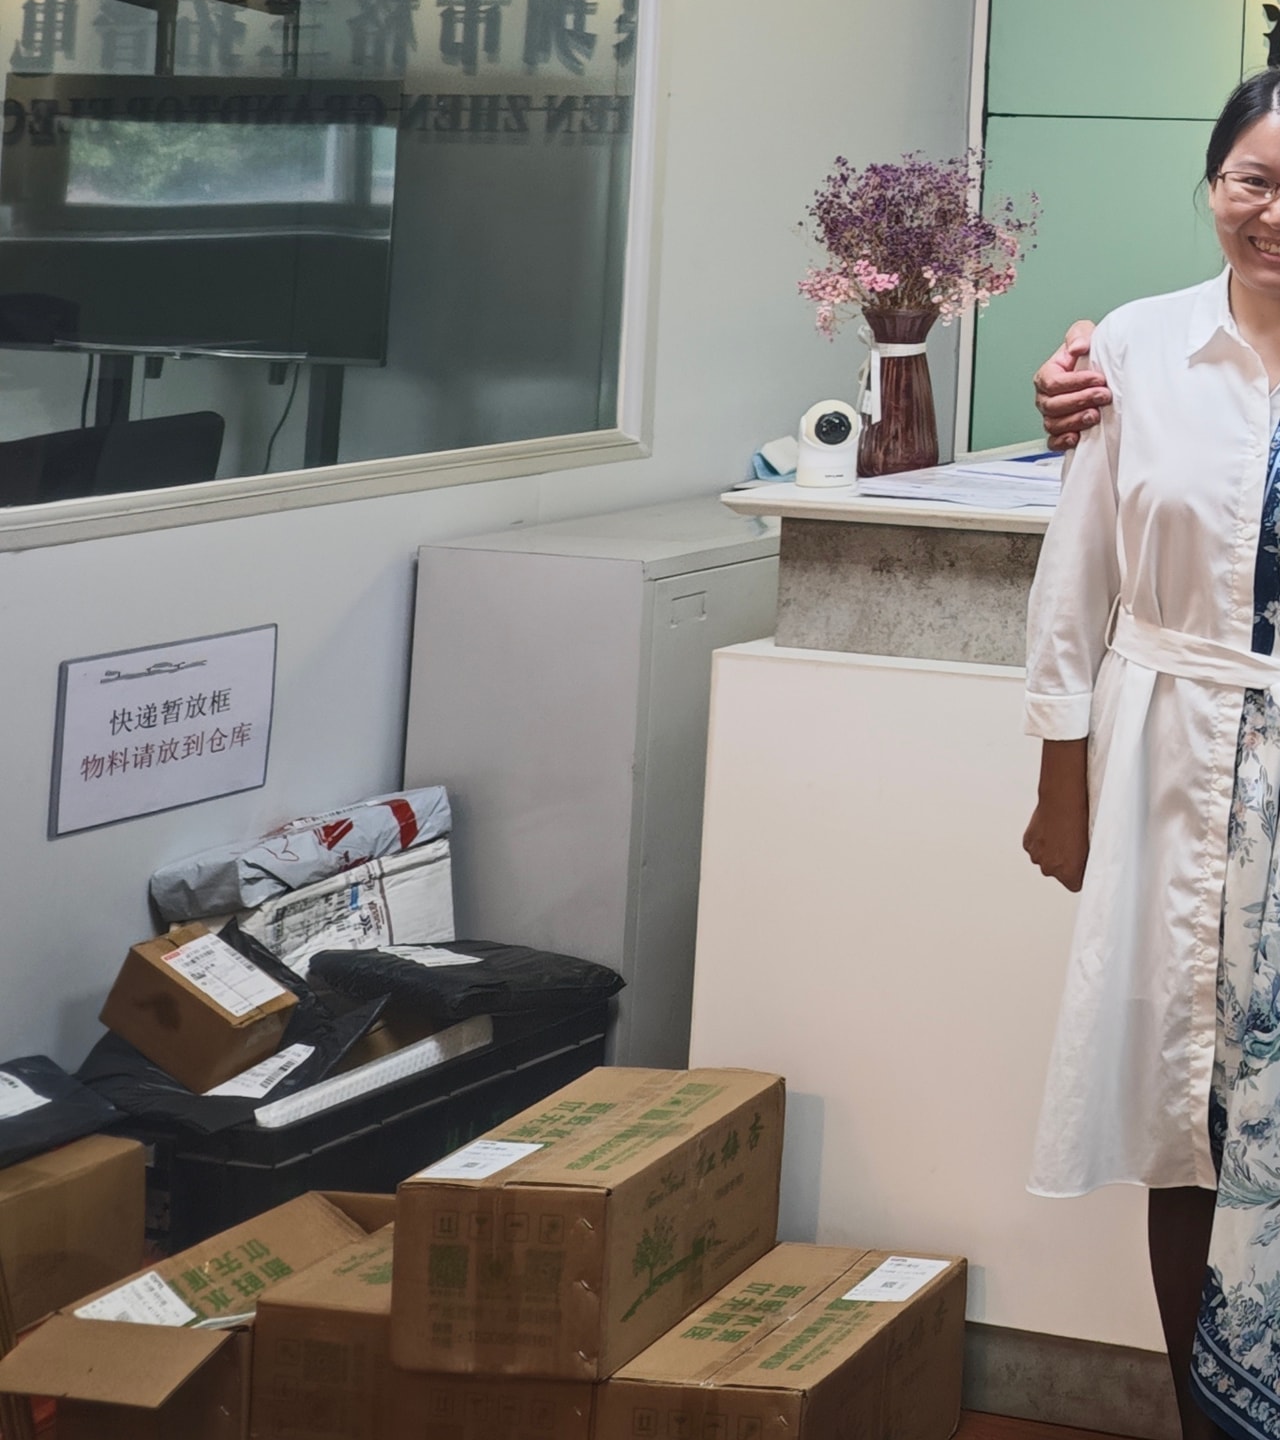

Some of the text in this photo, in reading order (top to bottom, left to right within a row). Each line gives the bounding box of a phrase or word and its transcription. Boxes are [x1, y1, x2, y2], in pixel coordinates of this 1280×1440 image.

[109, 687, 233, 736] 快递暂放框
[80, 721, 253, 782] 物料请放到仓库
[680, 1281, 776, 1341] 优先派送
[710, 1283, 807, 1344] 新鲜水果
